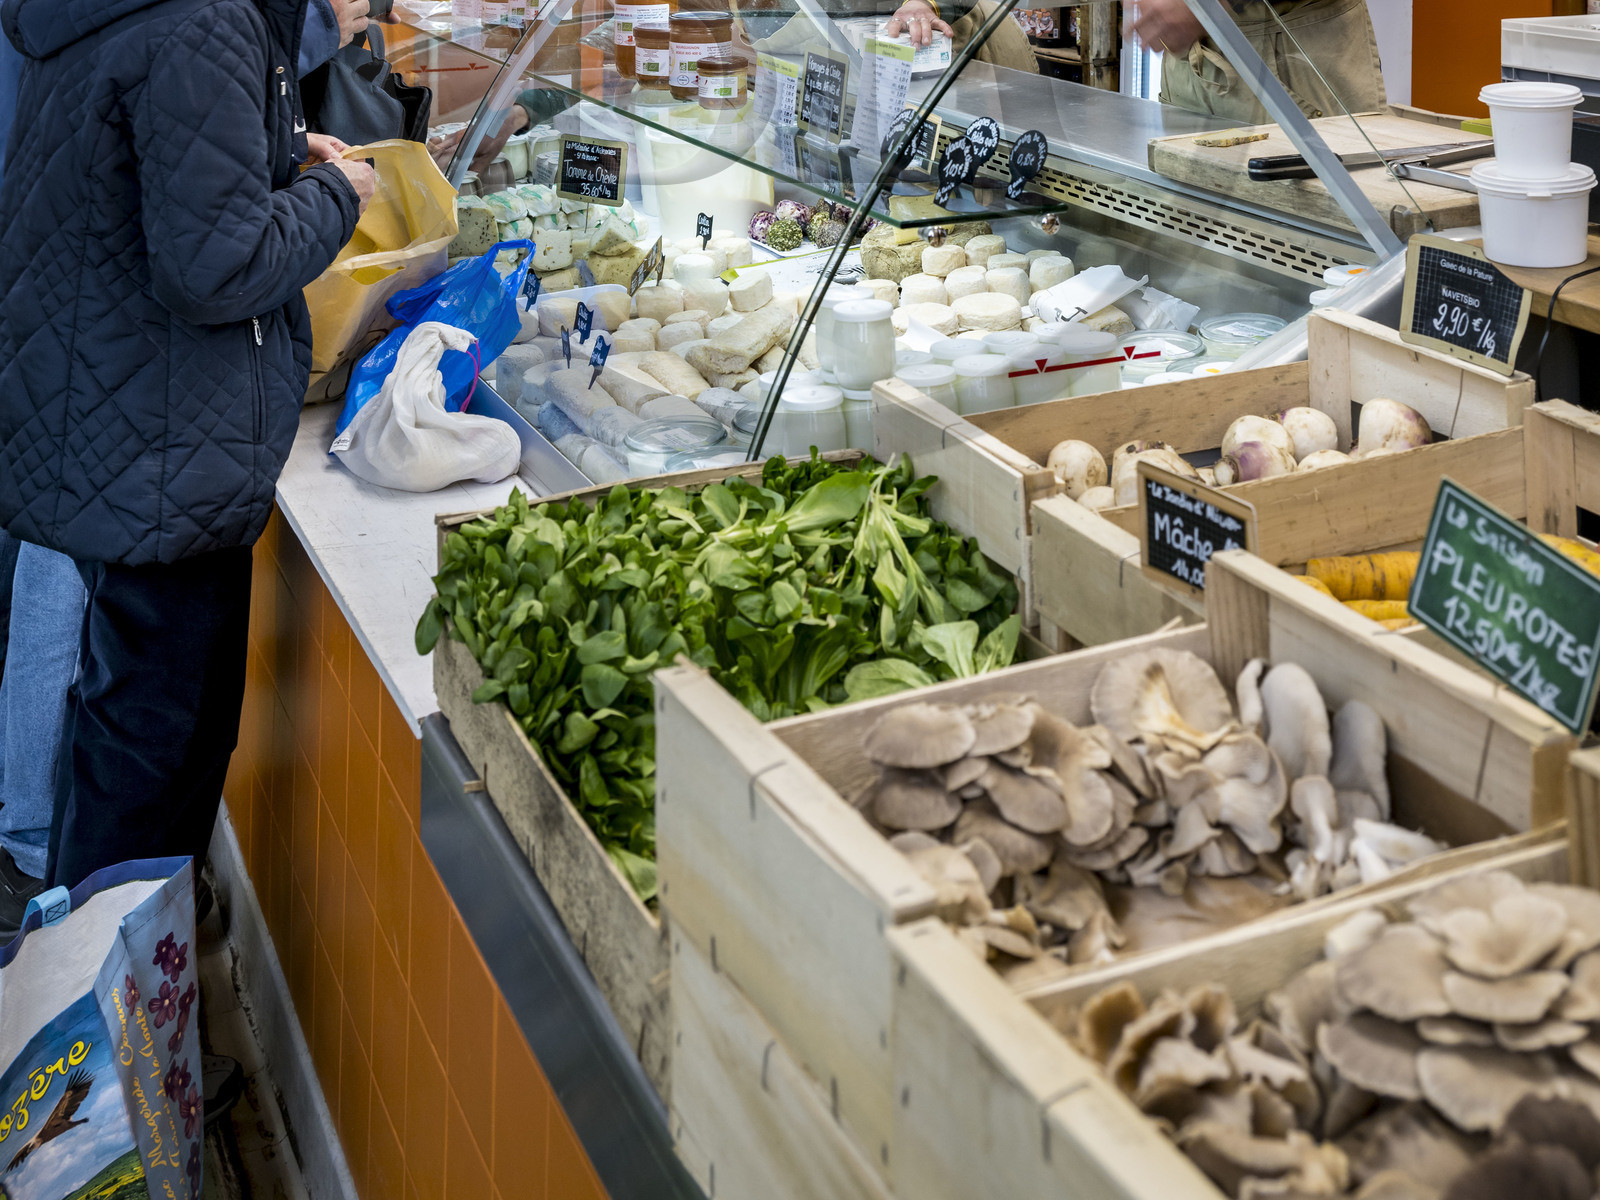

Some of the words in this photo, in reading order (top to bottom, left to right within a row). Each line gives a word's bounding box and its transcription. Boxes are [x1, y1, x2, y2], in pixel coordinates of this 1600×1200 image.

[1440, 258, 1458, 272] Gaec
[1458, 265, 1467, 274] de
[1466, 268, 1473, 276] la
[1154, 511, 1214, 563] Mâche
[1470, 517, 1545, 587] Saison
[1430, 539, 1593, 679] PLEUROTES
[0, 1040, 92, 1143] ozère
